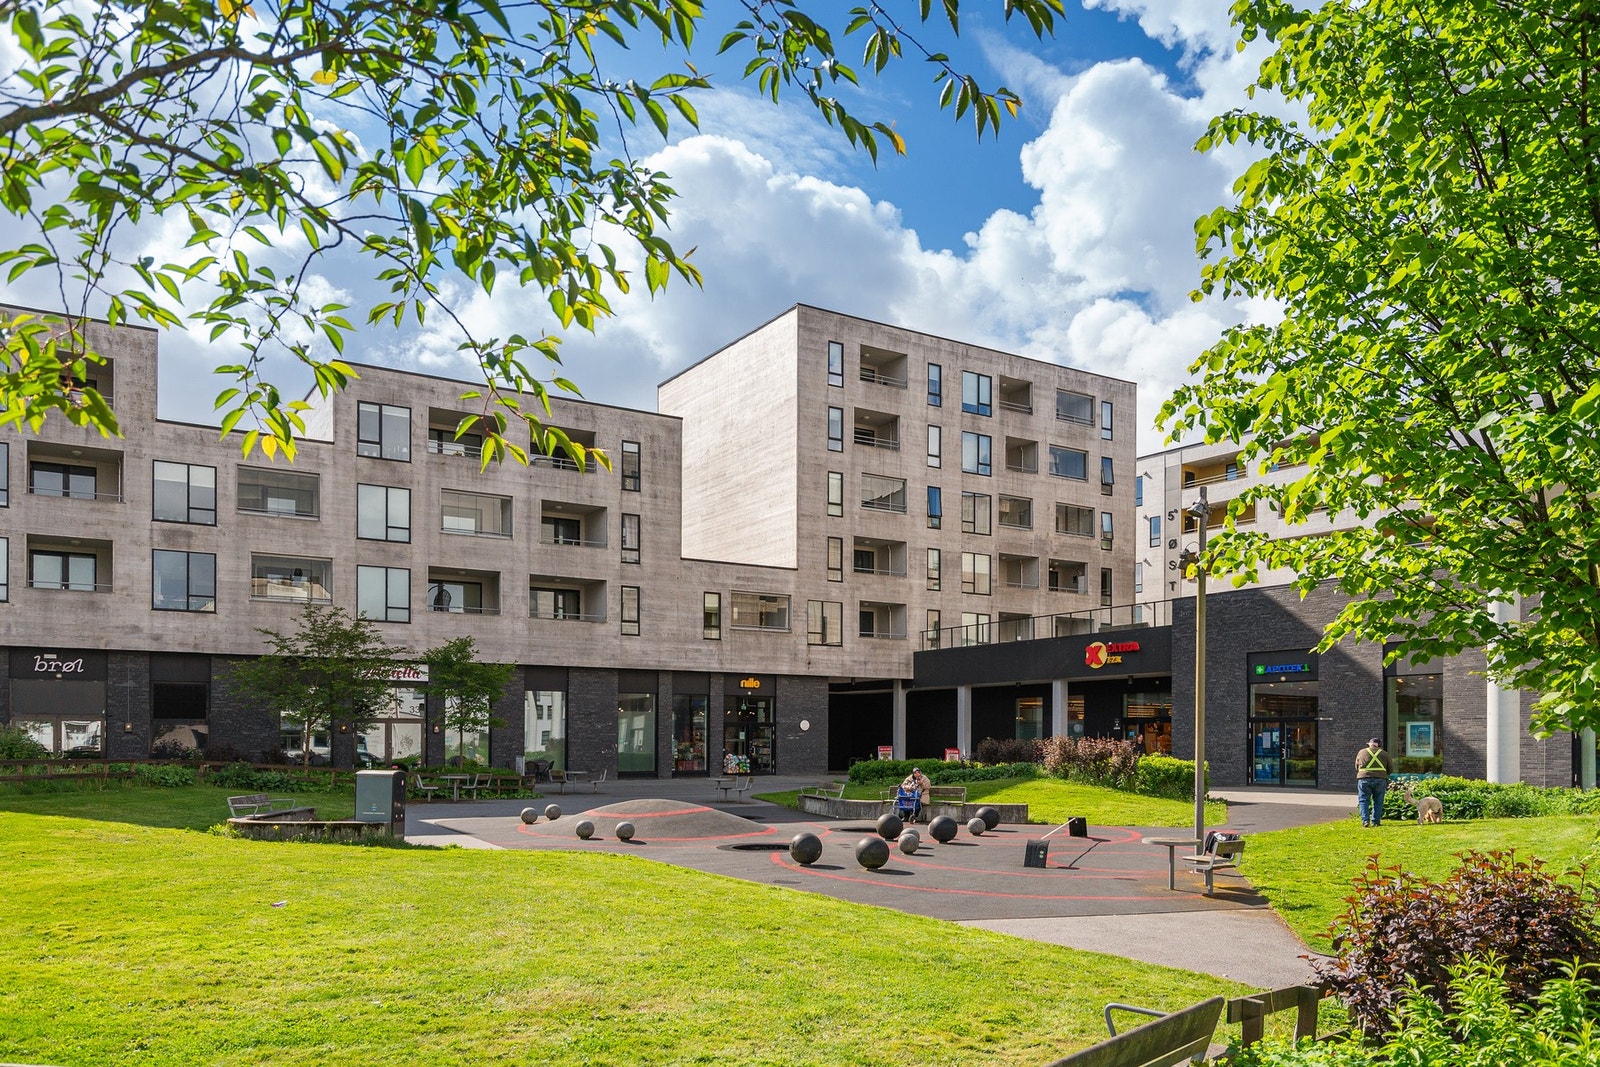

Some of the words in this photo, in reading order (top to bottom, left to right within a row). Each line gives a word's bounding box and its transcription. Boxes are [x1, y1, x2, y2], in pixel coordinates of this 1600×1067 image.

[1106, 641, 1139, 653] EXTRA
[34, 655, 84, 672] brøl
[1266, 663, 1303, 673] APOTEK
[740, 677, 760, 688] nille
